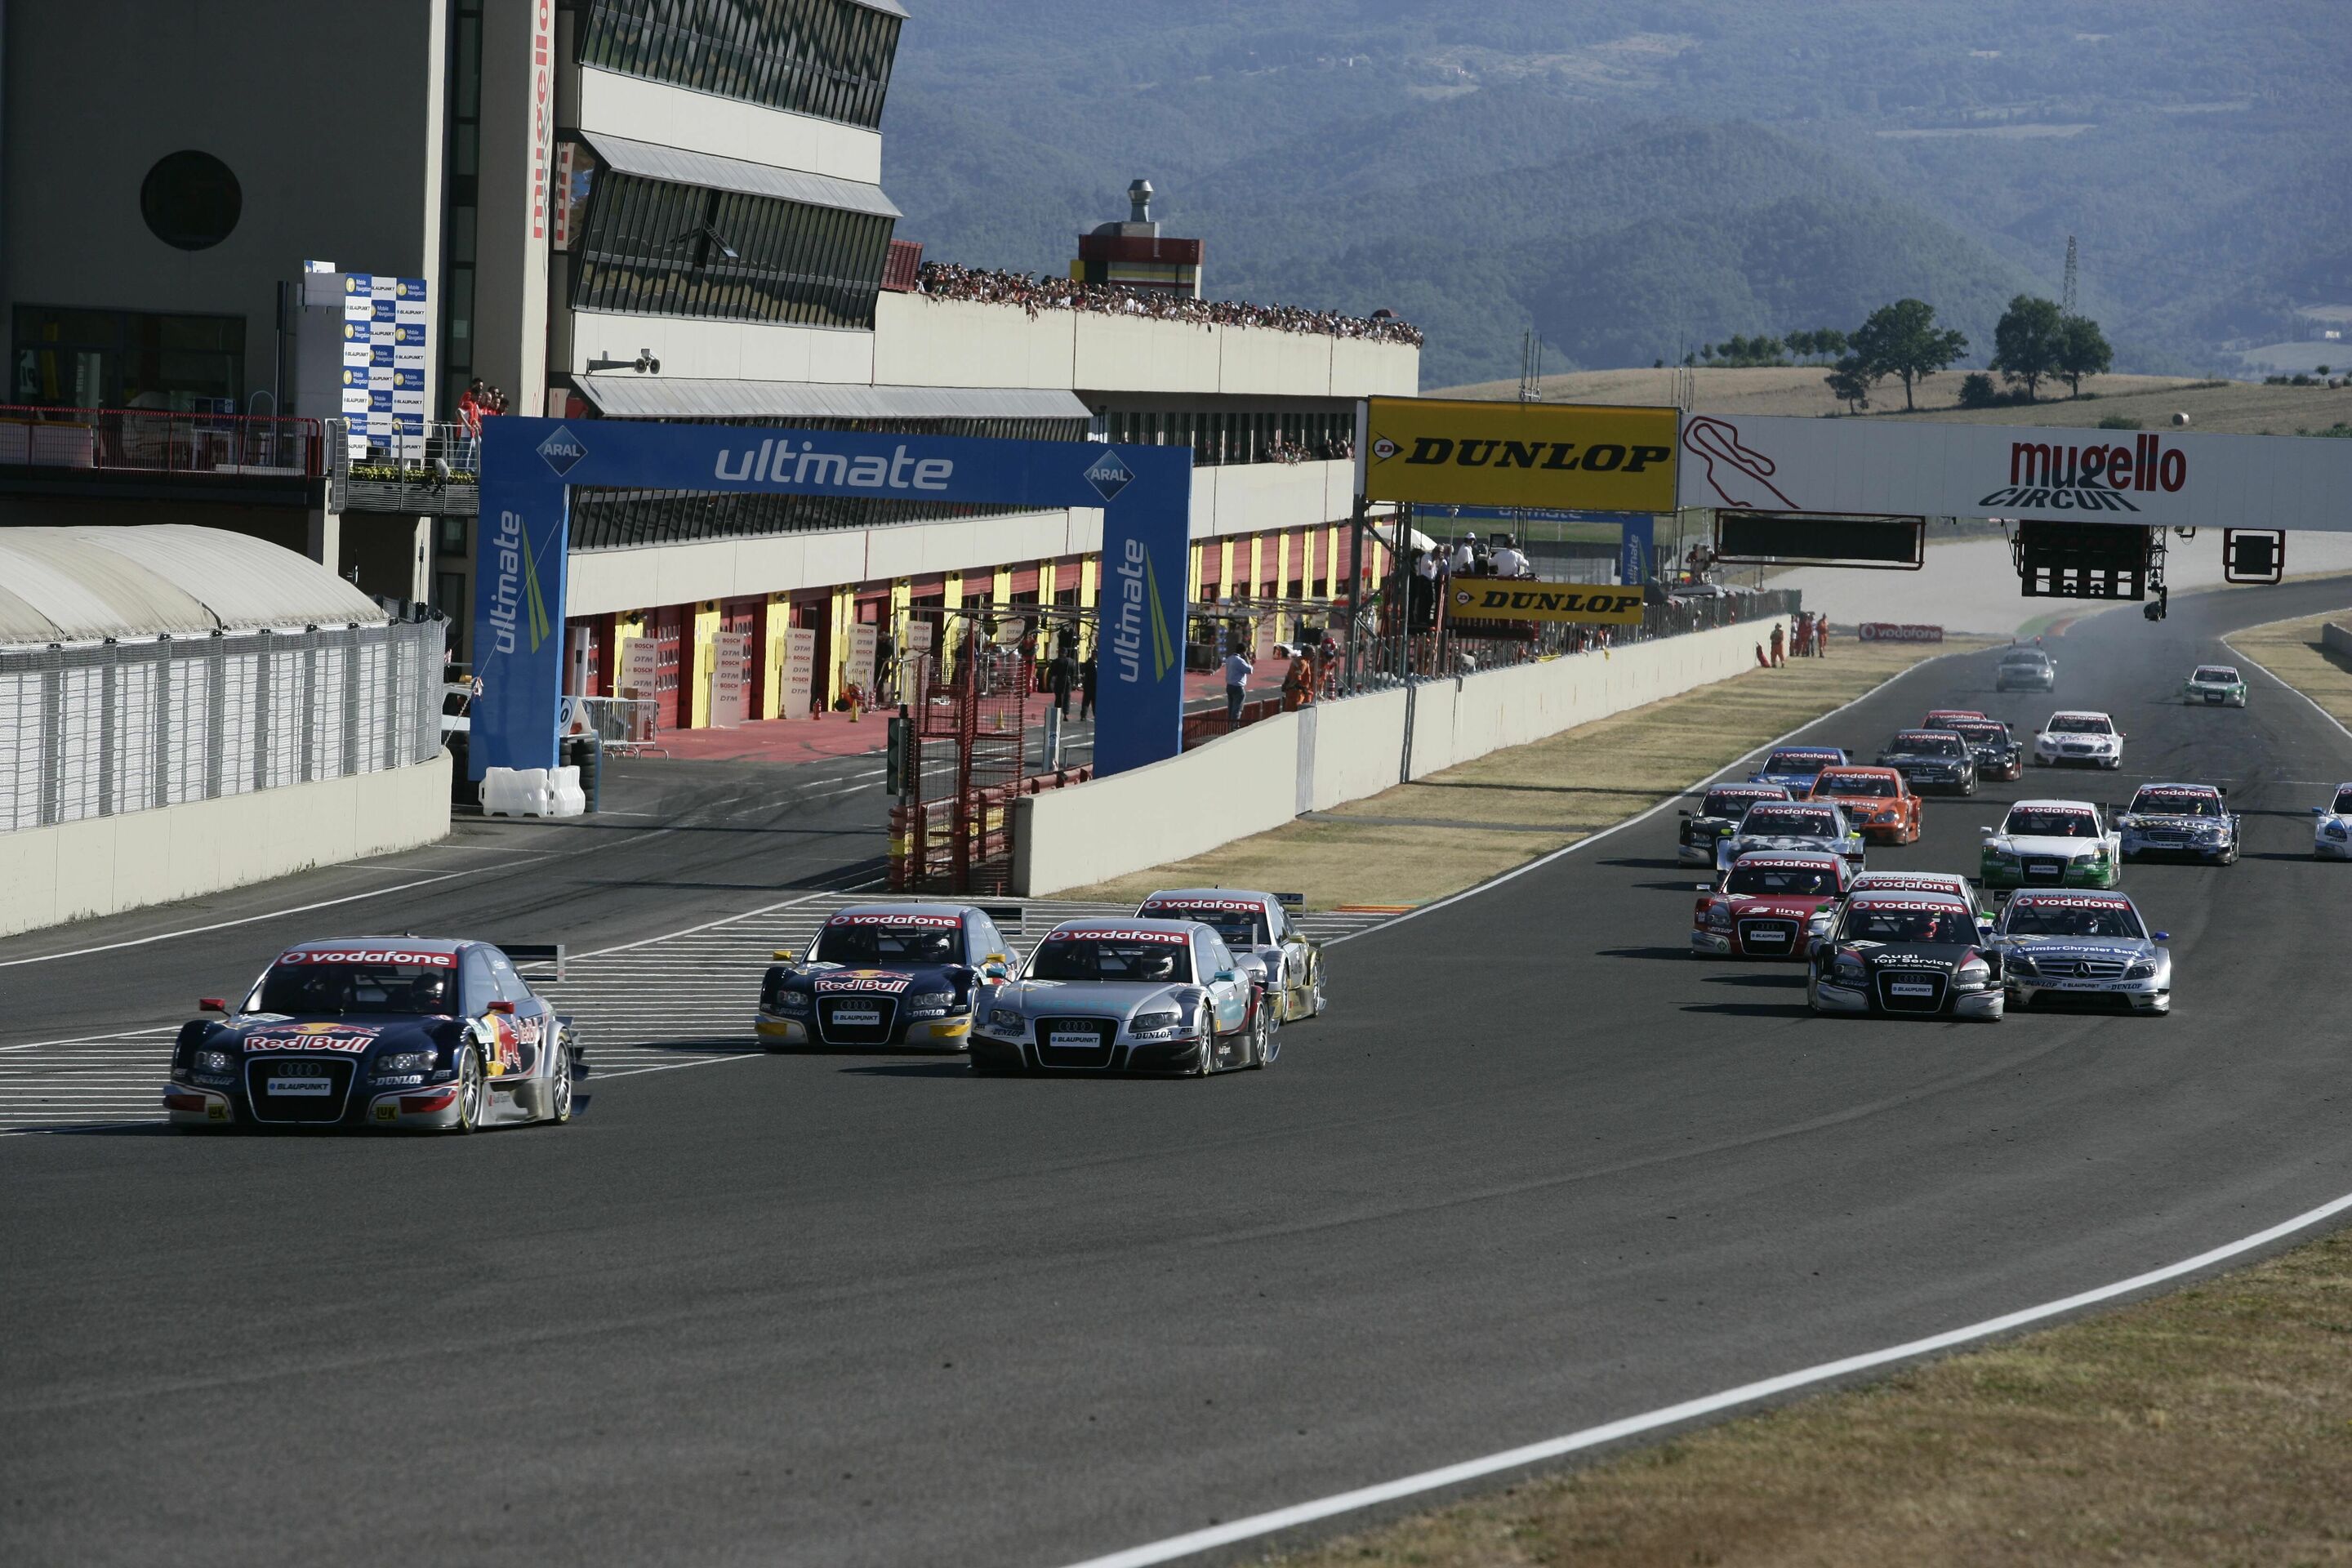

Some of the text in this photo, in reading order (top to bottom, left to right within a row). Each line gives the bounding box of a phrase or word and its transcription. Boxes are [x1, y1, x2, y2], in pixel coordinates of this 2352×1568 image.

[543, 443, 581, 457] ARAL
[1405, 437, 1671, 473] DUNLOP
[715, 439, 954, 490] ultimate
[2011, 434, 2187, 492] mugello
[1090, 469, 1128, 482] ARAL
[1978, 488, 2141, 512] CIRCUIT
[490, 510, 520, 655] ultimate
[1480, 590, 1641, 613] DUNLOP
[1113, 537, 1144, 683] ultimate
[1878, 625, 1940, 639] vodafone
[1722, 790, 1782, 798] vodafone
[2154, 789, 2212, 798] vodafone
[1767, 808, 1831, 817] vodafone
[2027, 807, 2090, 816] vodafone
[1754, 860, 1830, 869] vodafone
[1873, 880, 1954, 892] vodafone
[1165, 900, 1260, 911] vodafone
[1873, 902, 1964, 913] vodafone
[2037, 898, 2125, 909] vodafone
[853, 915, 956, 928] vodafone
[1074, 930, 1183, 943] vodafone
[311, 951, 450, 965] vodafone
[2114, 948, 2141, 957] Bank
[1902, 958, 1953, 966] Service
[816, 980, 906, 992] Red Bull
[1135, 1031, 1173, 1040] DUNLOP
[245, 1036, 372, 1052] Red Bull
[376, 1075, 424, 1085] DUNLOP
